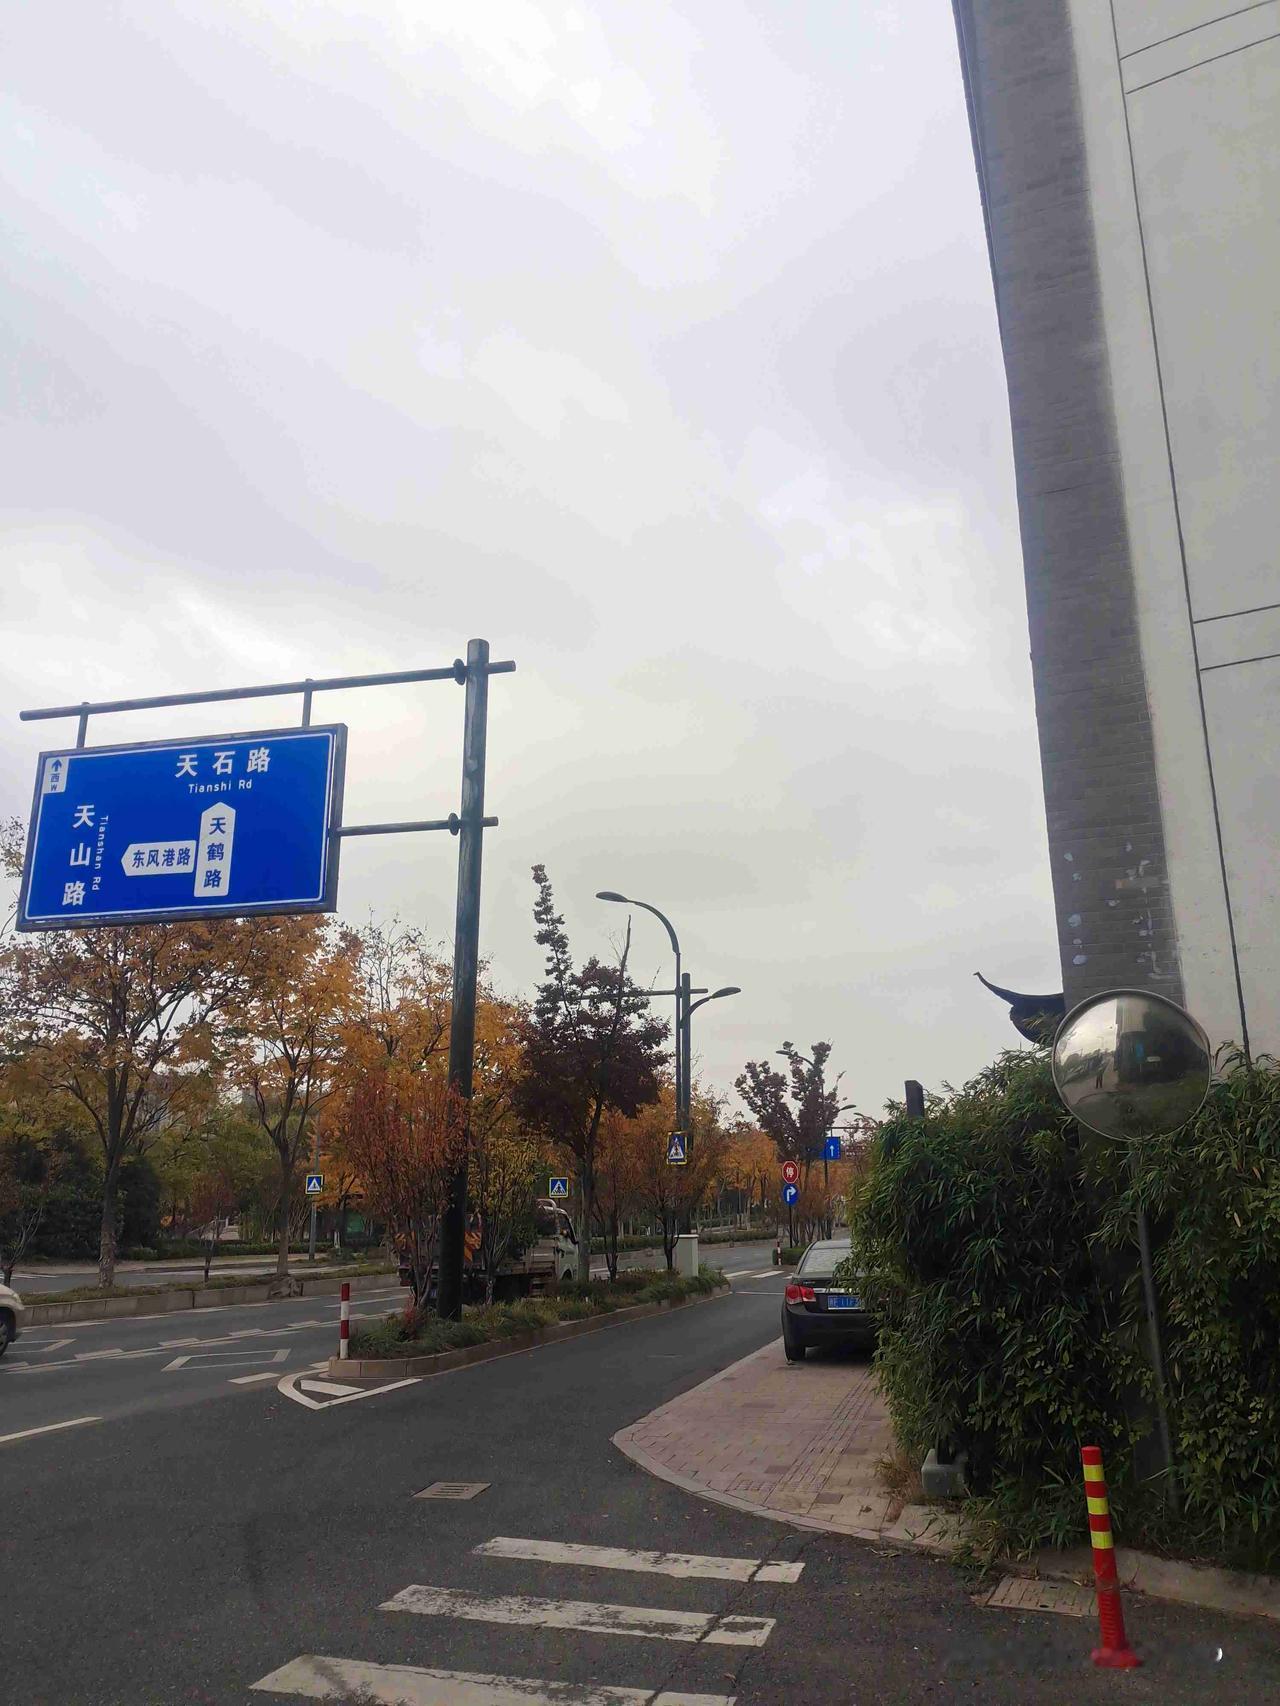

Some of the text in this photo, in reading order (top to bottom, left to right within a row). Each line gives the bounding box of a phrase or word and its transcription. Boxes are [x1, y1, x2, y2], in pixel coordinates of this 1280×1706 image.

[175, 747, 271, 778] 天石路
[50, 773, 60, 782] 西
[50, 783, 58, 791] W
[188, 779, 252, 793] Tianshi Rd
[61, 804, 95, 907] 天山路
[91, 815, 109, 891] Tianshan Rd
[132, 847, 191, 868] 东风港路
[203, 817, 226, 888] 天鹤路
